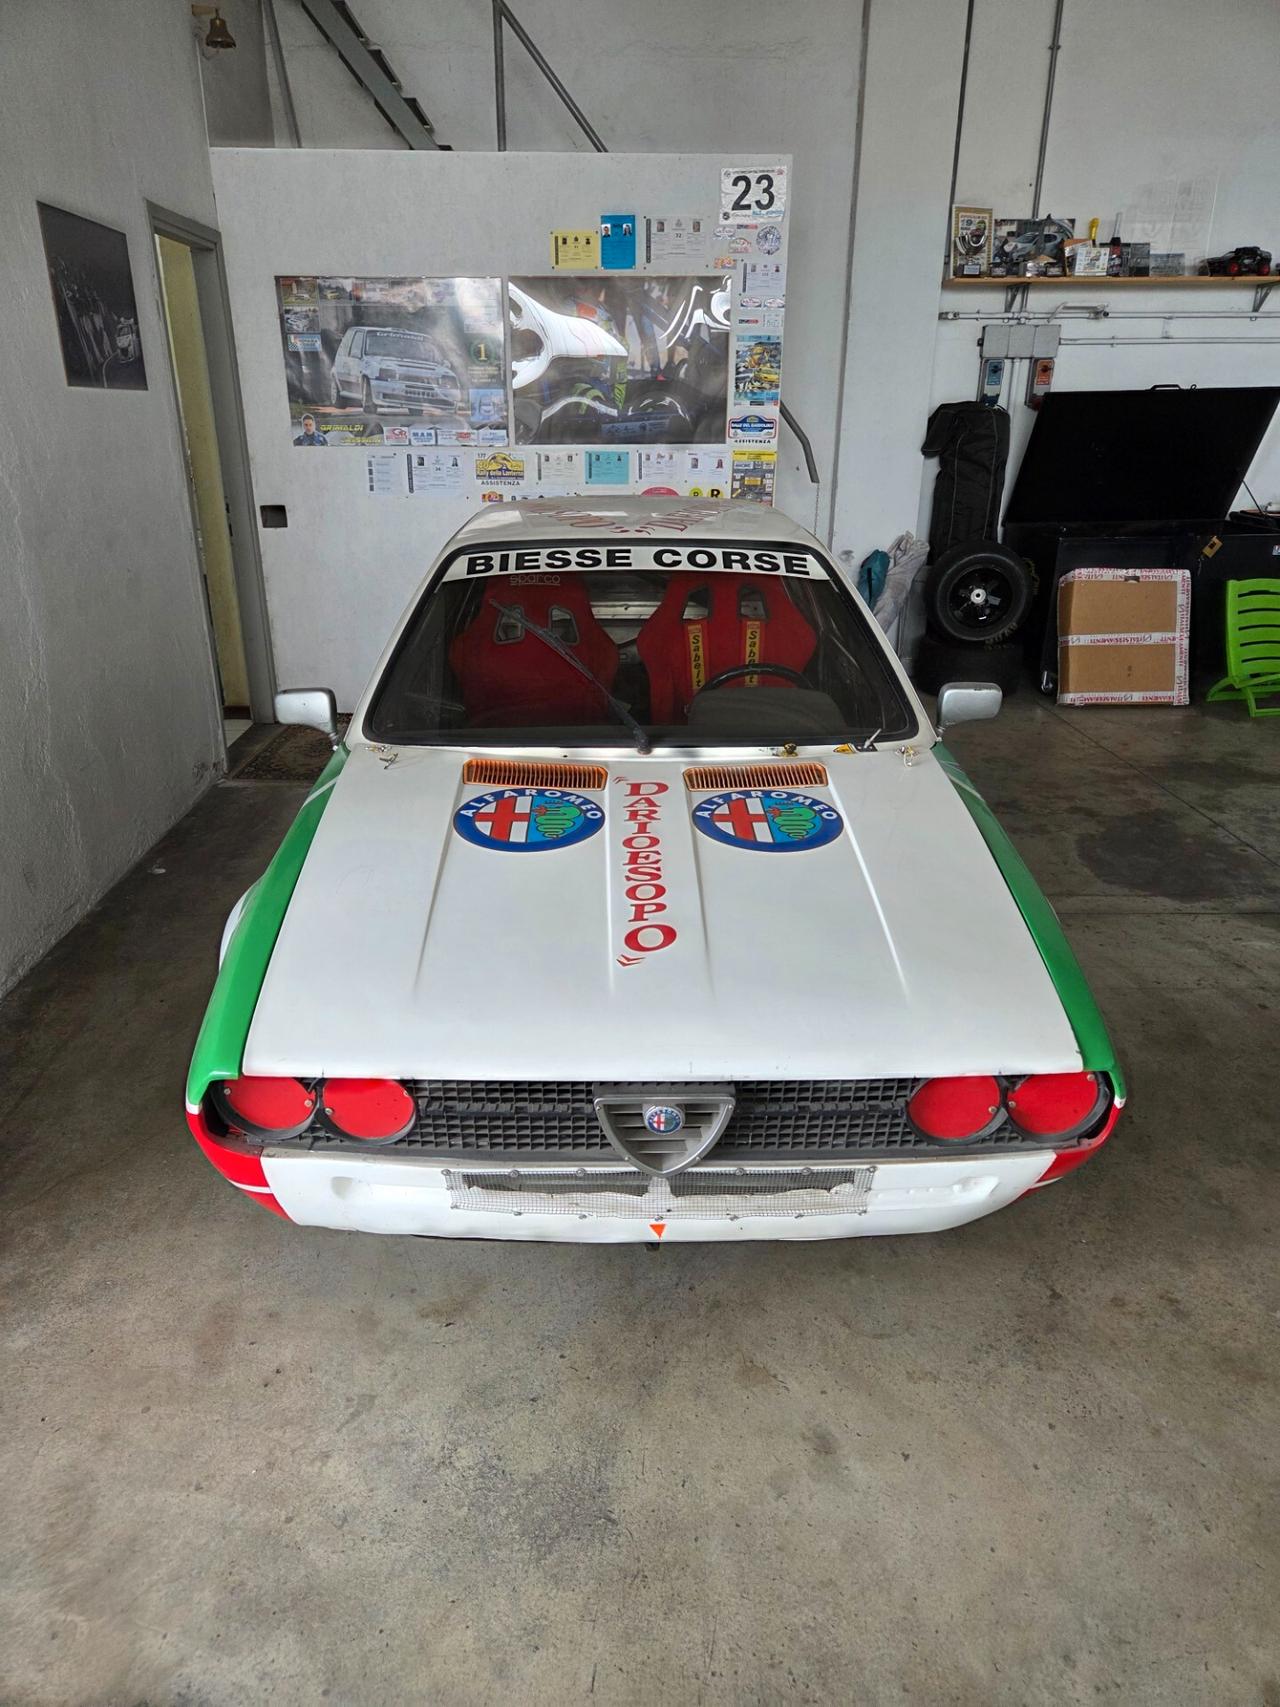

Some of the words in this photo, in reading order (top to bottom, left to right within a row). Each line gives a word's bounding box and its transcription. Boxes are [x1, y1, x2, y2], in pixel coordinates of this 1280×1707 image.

[731, 174, 775, 211] 23
[477, 343, 488, 361] 1
[320, 424, 364, 432] GRIMALDI
[466, 549, 632, 576] BIESSE
[653, 549, 811, 576] CORSE
[510, 574, 561, 586] sparco
[692, 634, 702, 688] Sabelt
[747, 630, 758, 684] Sabet
